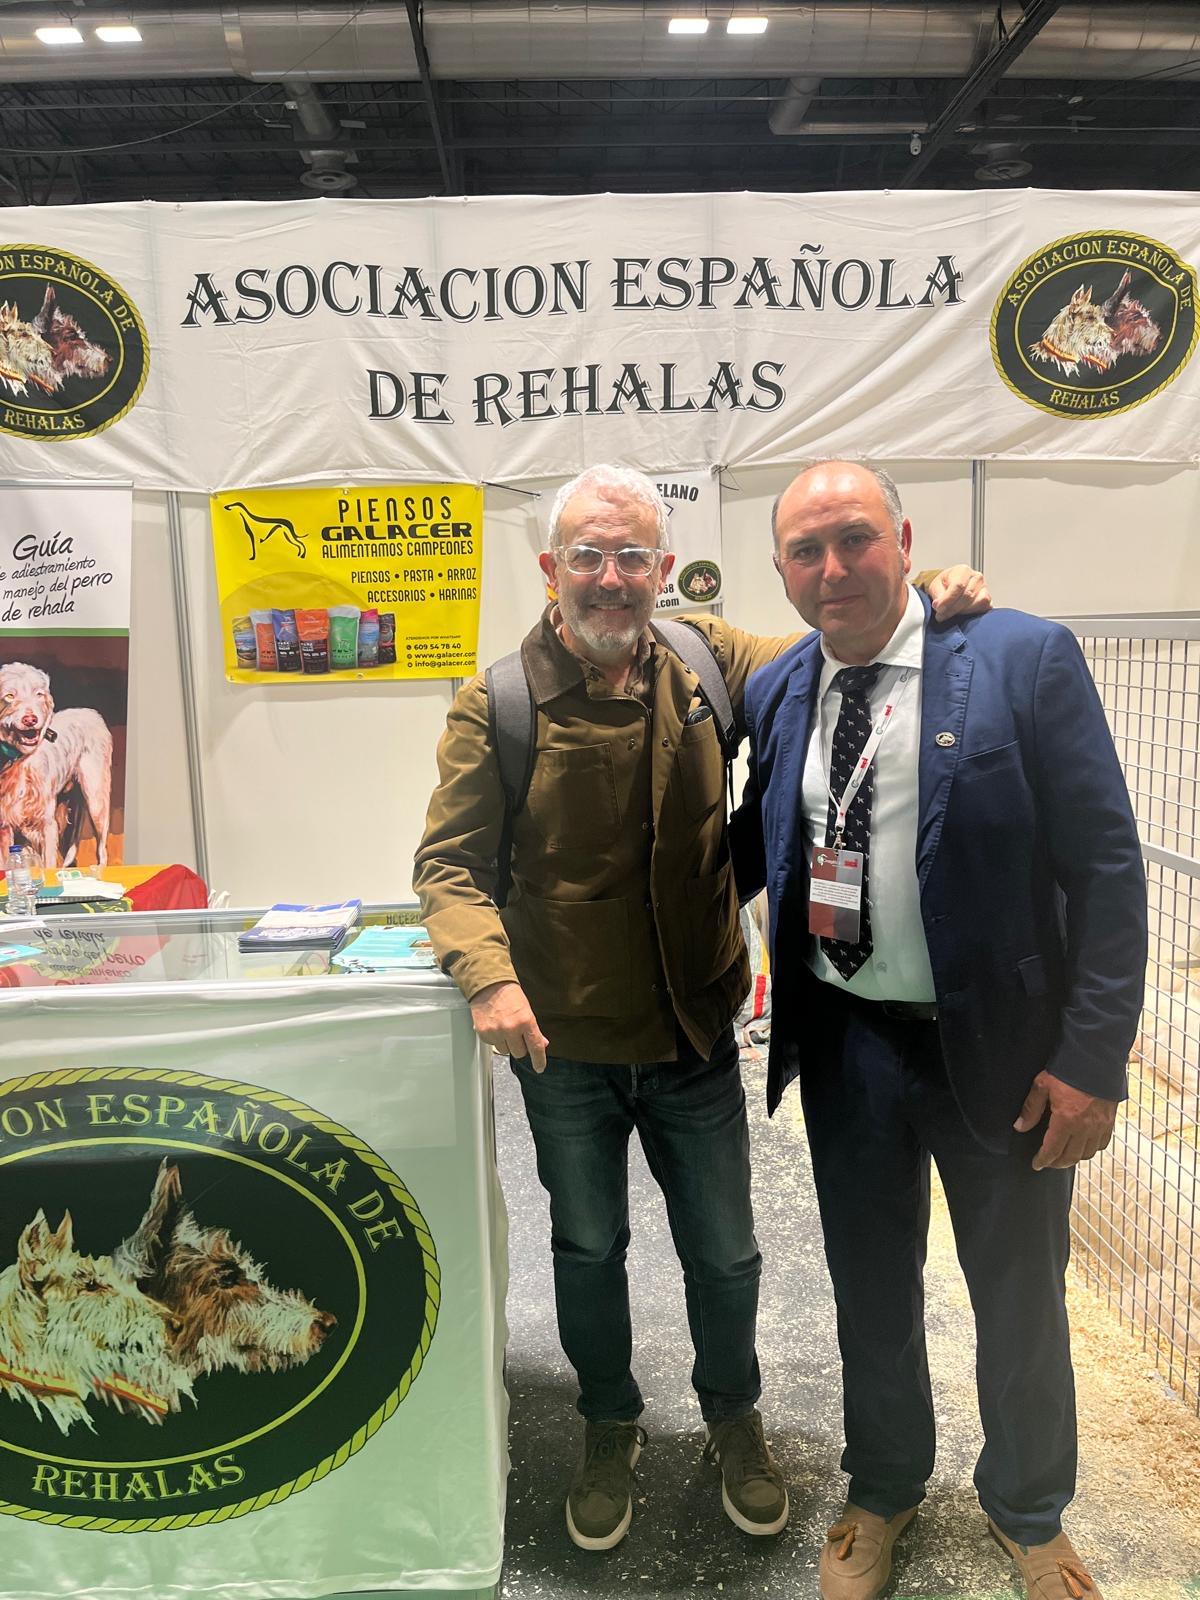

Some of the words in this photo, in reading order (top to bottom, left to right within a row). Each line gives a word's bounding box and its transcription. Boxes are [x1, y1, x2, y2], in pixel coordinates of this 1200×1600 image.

[181, 259, 591, 328] ASOCIACION
[609, 243, 966, 312] ESPAÑOLA
[1007, 239, 1102, 307] ASOCIACION
[1106, 239, 1186, 286] ESPAÑOLA
[1179, 283, 1192, 311] DE
[20, 253, 115, 305] ESPAÑOLA
[113, 304, 136, 332] DE
[366, 368, 455, 426] DE
[470, 359, 788, 430] REHALAS
[1049, 388, 1121, 409] REHALAS
[4, 408, 86, 430] REHALAS
[338, 495, 452, 523] PIENSOS
[13, 530, 74, 561] Guía
[321, 522, 473, 541] GALACER
[322, 542, 403, 559] ALIMENTAMOS
[406, 540, 474, 556] CAMPEONES
[11, 555, 96, 580] adiestramiento
[351, 570, 391, 584] PIENSOS
[403, 569, 434, 582] PASTA
[447, 568, 477, 581] ARROZ
[3, 580, 46, 601] manejo
[50, 574, 69, 592] del
[70, 571, 113, 596] perro
[367, 589, 426, 603] ACCESORIOS
[439, 587, 477, 601] HARINAS
[1, 601, 22, 622] de
[28, 592, 75, 619] rehala
[655, 597, 680, 608] .com
[86, 1093, 350, 1194] ESPAÑOLA
[348, 1190, 405, 1252] DE
[32, 1454, 246, 1502] REHALAS
